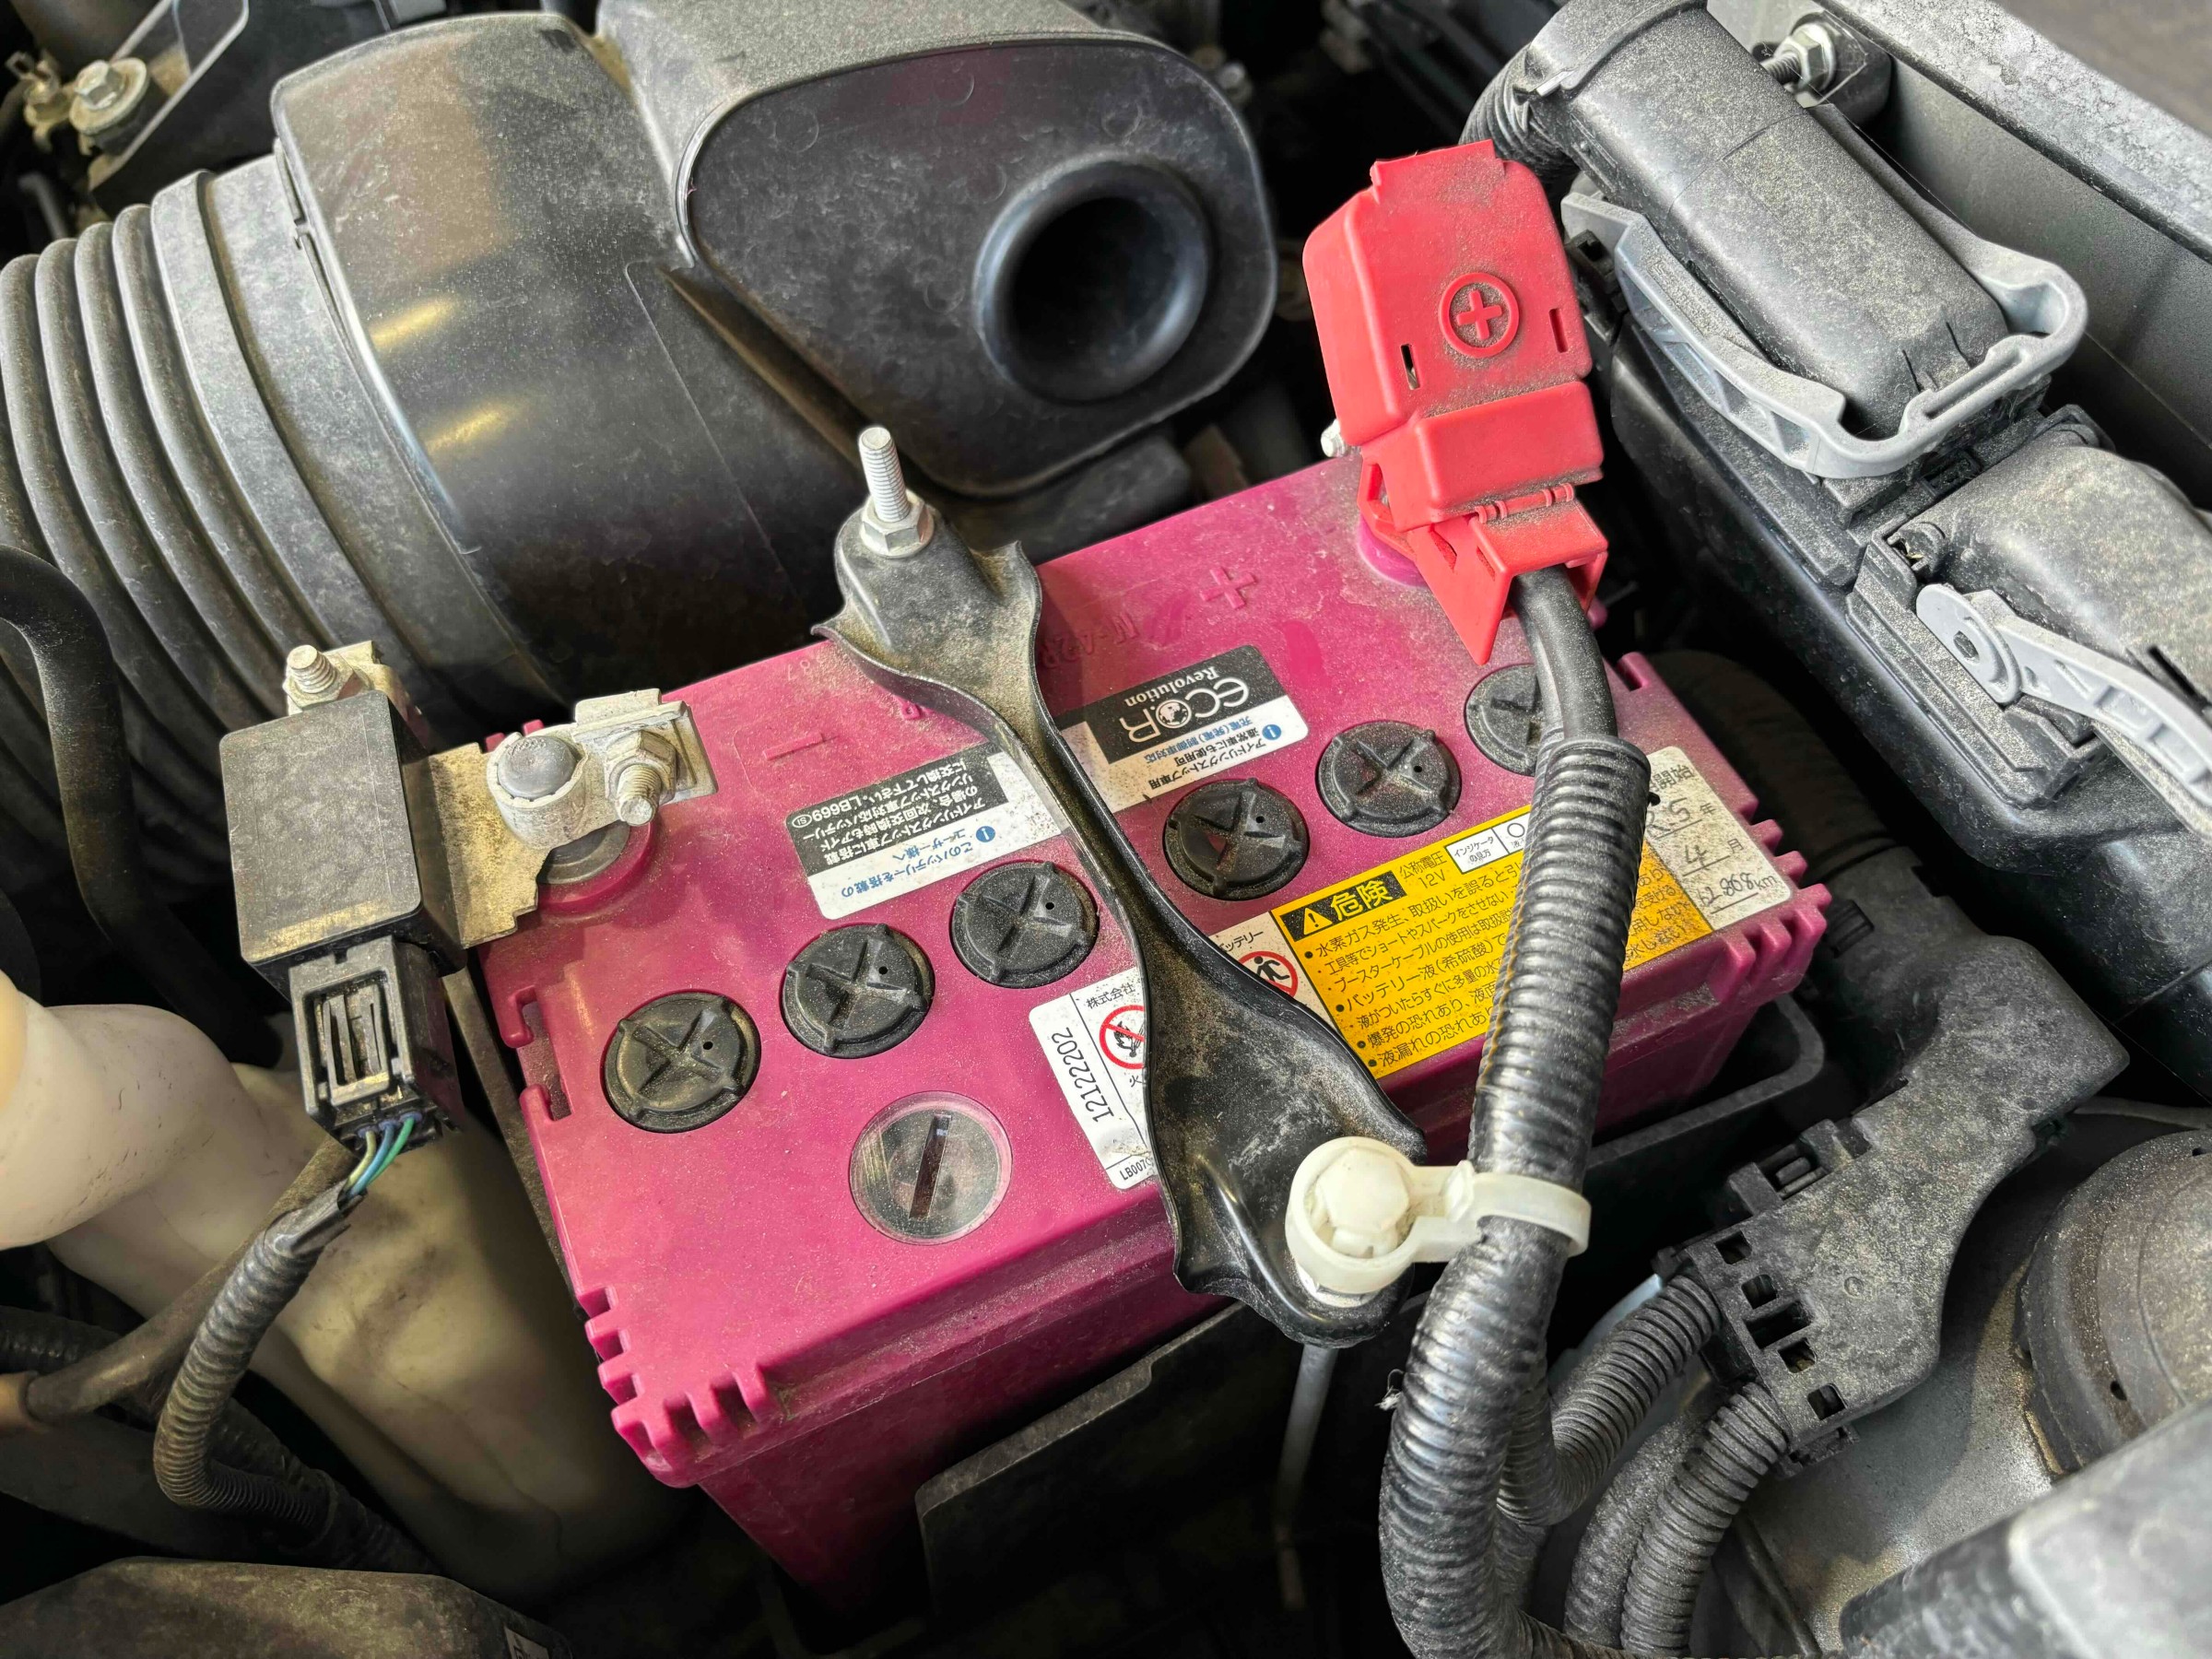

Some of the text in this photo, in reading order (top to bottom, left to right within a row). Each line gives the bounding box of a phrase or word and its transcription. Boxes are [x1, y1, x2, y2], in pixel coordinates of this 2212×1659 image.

[1123, 665, 1219, 710] Revolution
[1147, 735, 1265, 790] アイドリングストップ車用
[1172, 726, 1259, 767] 通常車にも使用可
[801, 769, 972, 845] リングストップ車対応バッテリー
[809, 794, 862, 822] LB669
[818, 782, 979, 853] の場合、次回交換時もアイド
[1699, 801, 1717, 818] 年
[823, 794, 985, 865] アイドリングストップ車に搭載
[891, 827, 967, 863] ユーザー様へ
[1453, 835, 1495, 858] インジケータ
[1726, 836, 1745, 853] 月
[839, 839, 973, 900] このバッテリーを搭載の
[1397, 849, 1447, 879] 公称電圧
[1417, 868, 1447, 889] 12V
[1328, 877, 1394, 922] 危険
[1333, 906, 1514, 993] ブースターケーブルの使用は取扱説
[1085, 981, 1136, 1009] 株式会社
[1051, 1025, 1113, 1122] 12122202
